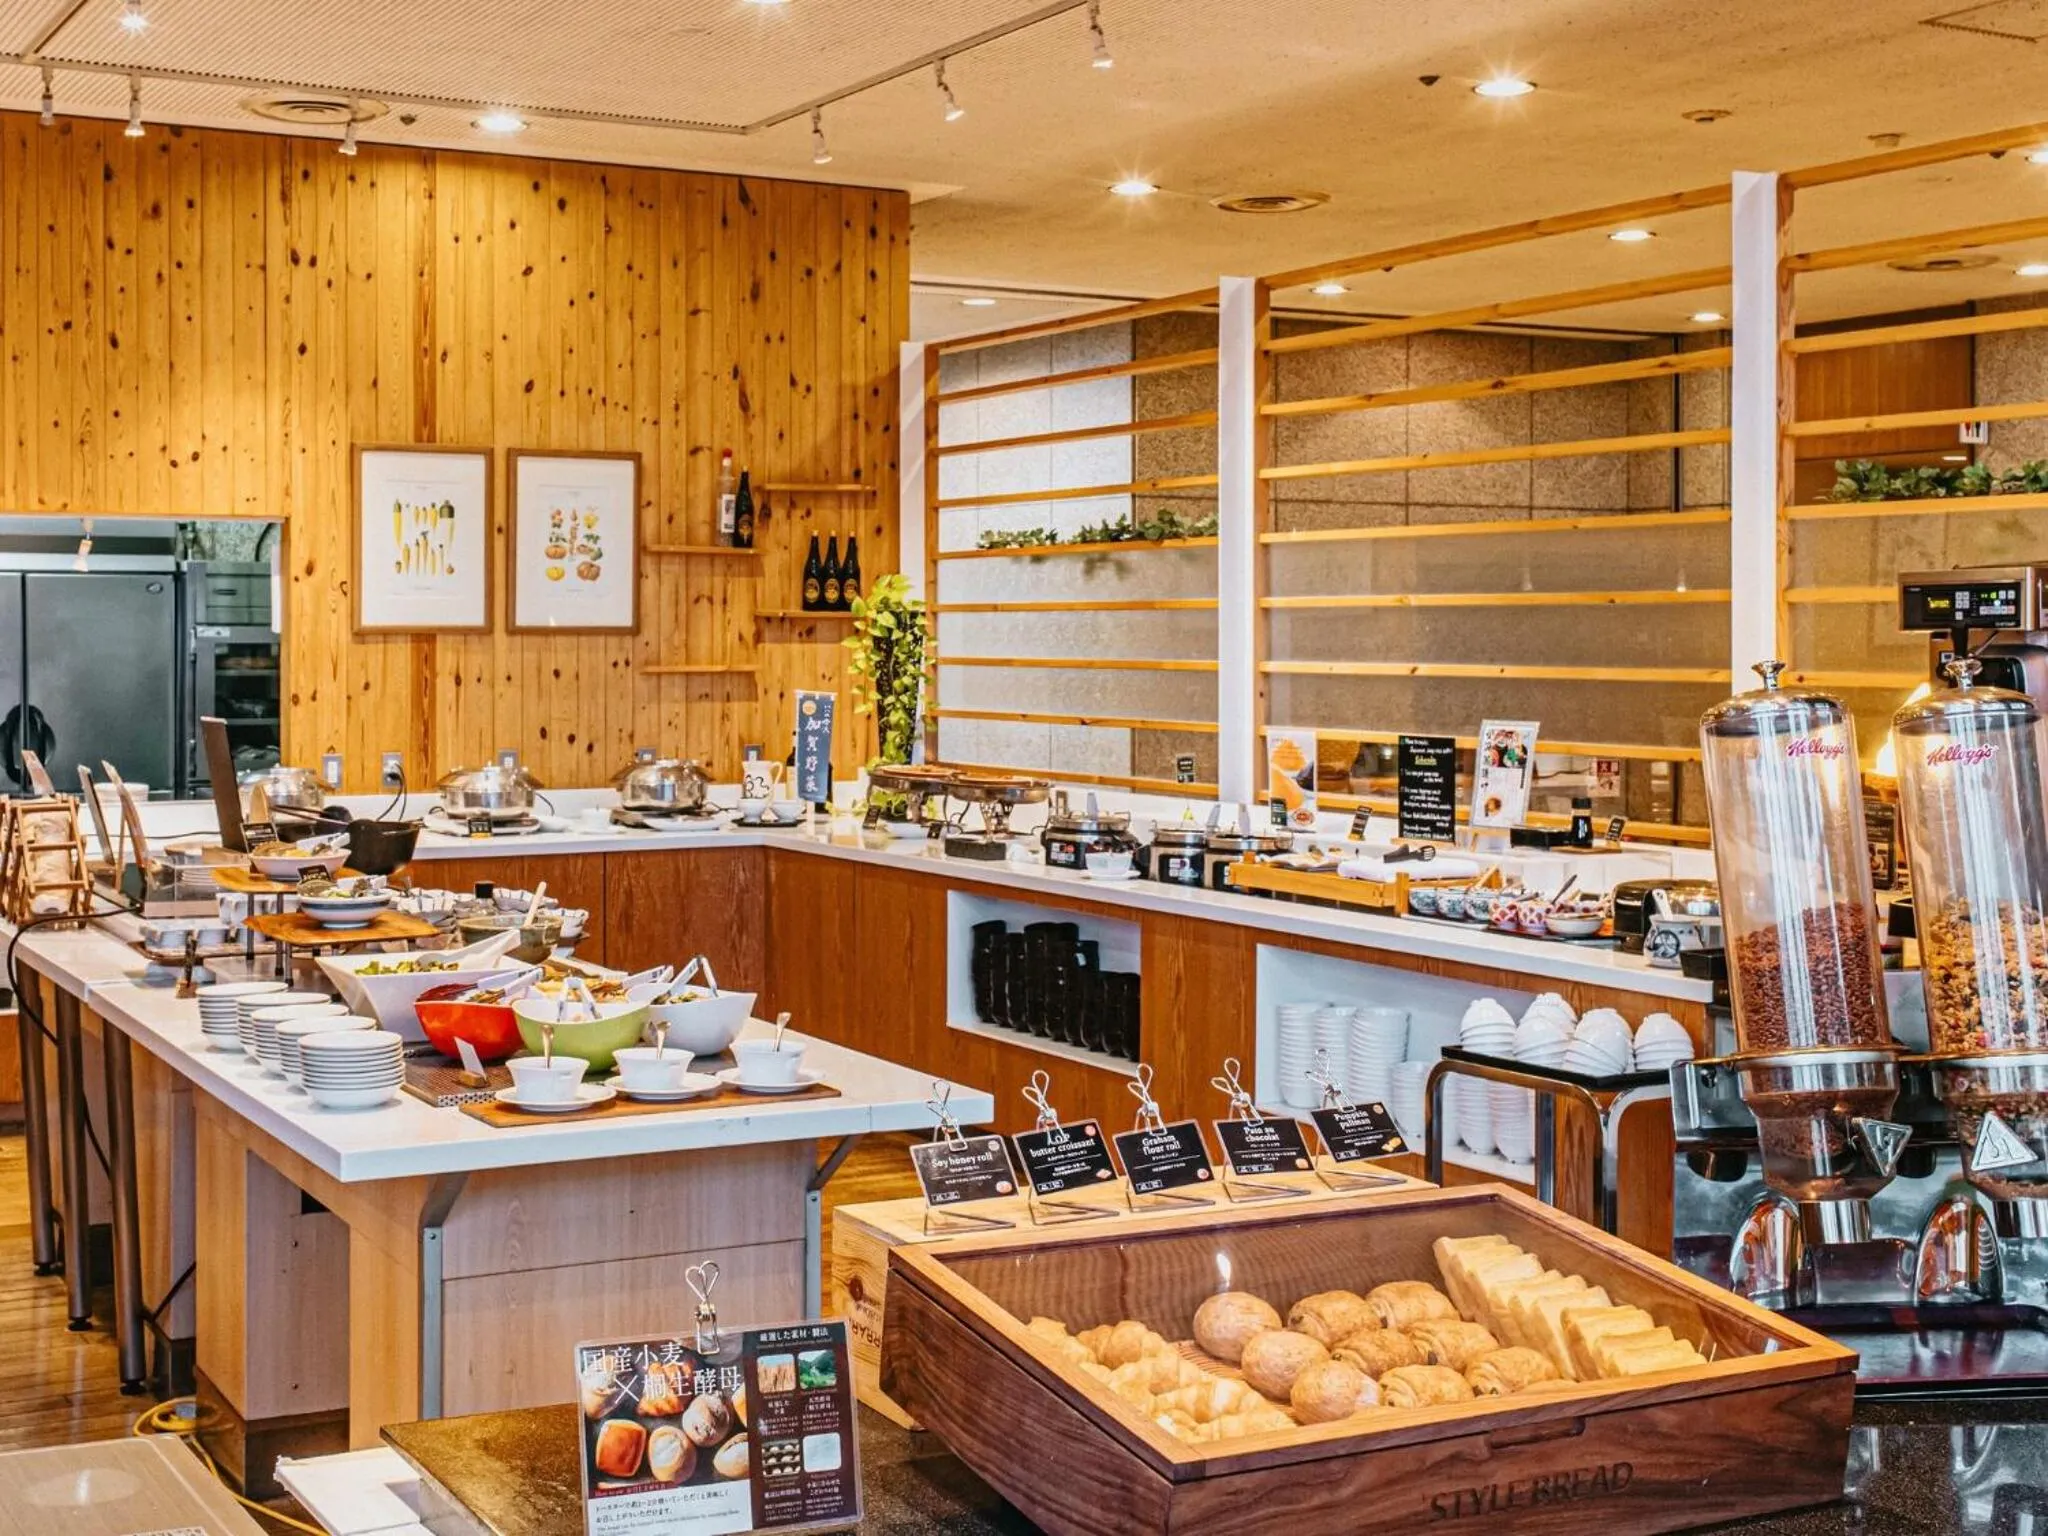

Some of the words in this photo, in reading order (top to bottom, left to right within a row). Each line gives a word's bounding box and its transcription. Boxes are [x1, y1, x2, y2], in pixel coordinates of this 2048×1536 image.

[805, 716, 821, 793] 加賀野菜
[1787, 737, 1845, 760] Kellogg's
[1927, 743, 1993, 766] Kellogg's
[1029, 1146, 1057, 1157] butter
[1058, 1139, 1096, 1152] croissant
[1142, 1135, 1176, 1146] Graham
[1166, 1141, 1181, 1151] roll
[949, 1155, 976, 1166] honey
[977, 1151, 993, 1162] roll
[582, 1342, 685, 1374] 国産小麦
[1429, 1479, 1524, 1522] STYLE
[1531, 1462, 1634, 1505] BREAD
